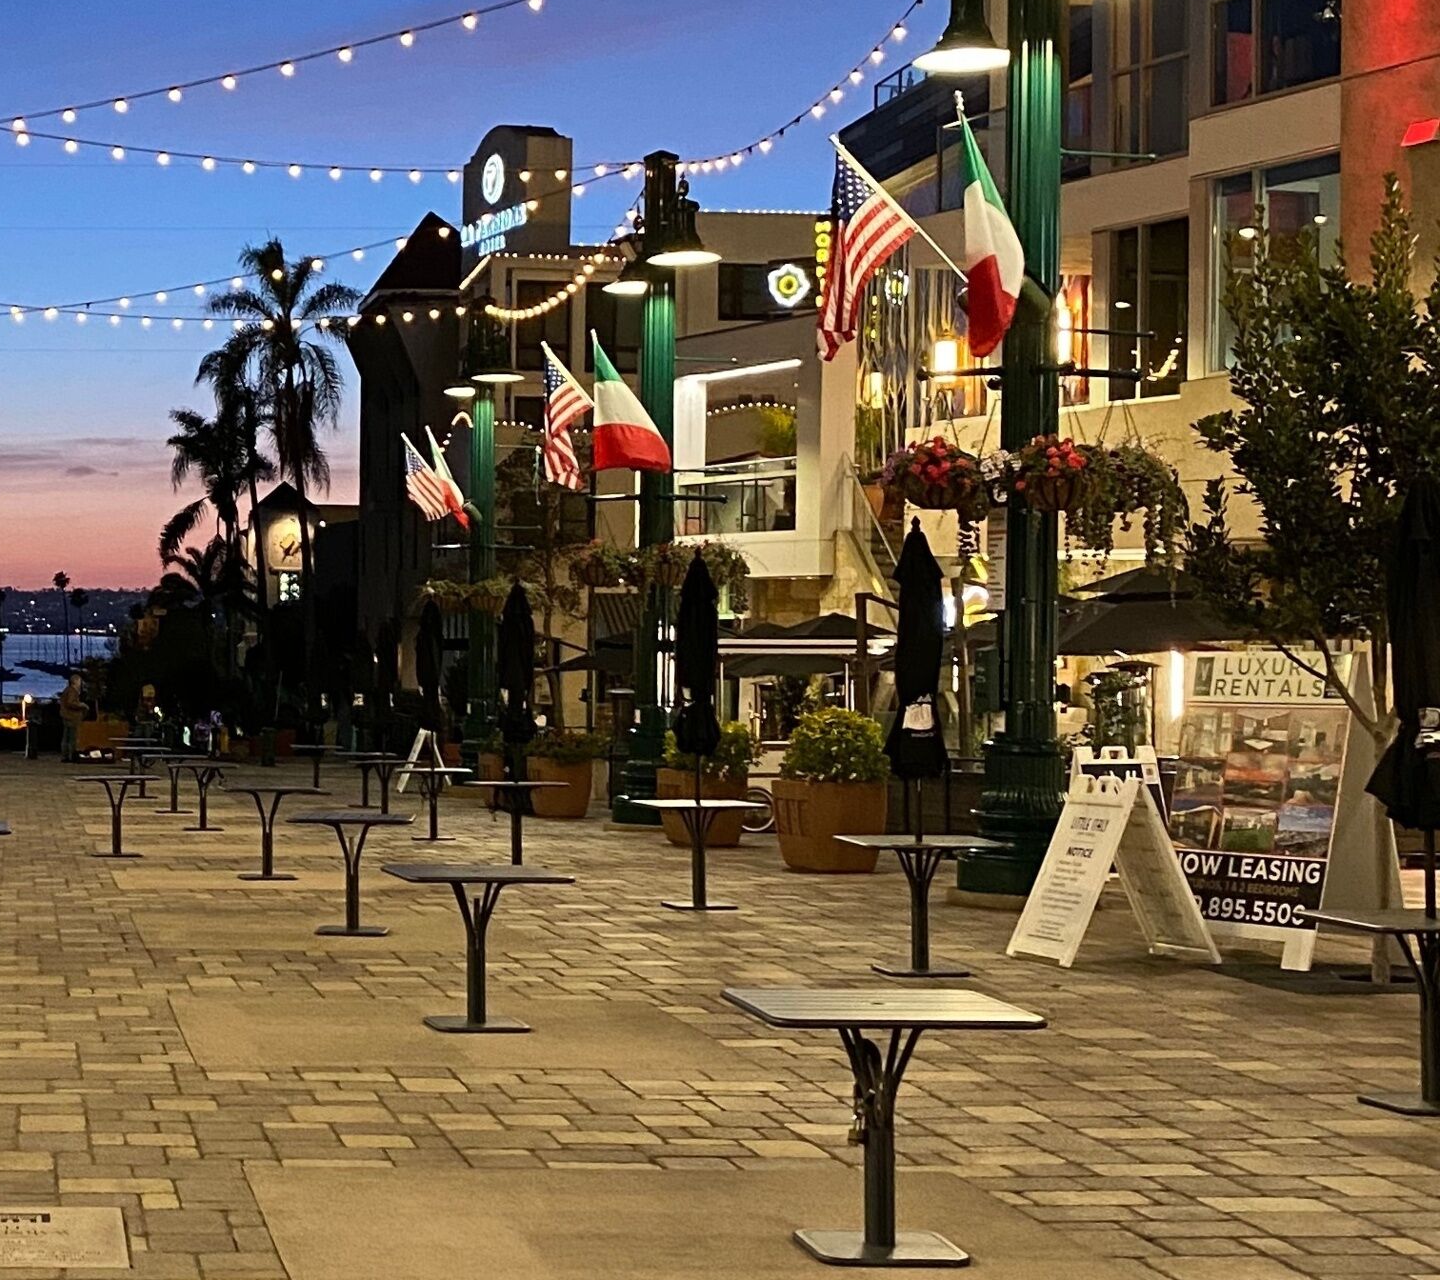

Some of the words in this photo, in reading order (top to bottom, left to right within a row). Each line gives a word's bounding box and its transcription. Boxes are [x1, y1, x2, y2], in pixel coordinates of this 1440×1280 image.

[1223, 658, 1320, 675] LUXURY
[1213, 678, 1323, 698] RENTALS
[1066, 846, 1094, 859] NOTICE
[1227, 857, 1321, 885] LEASING
